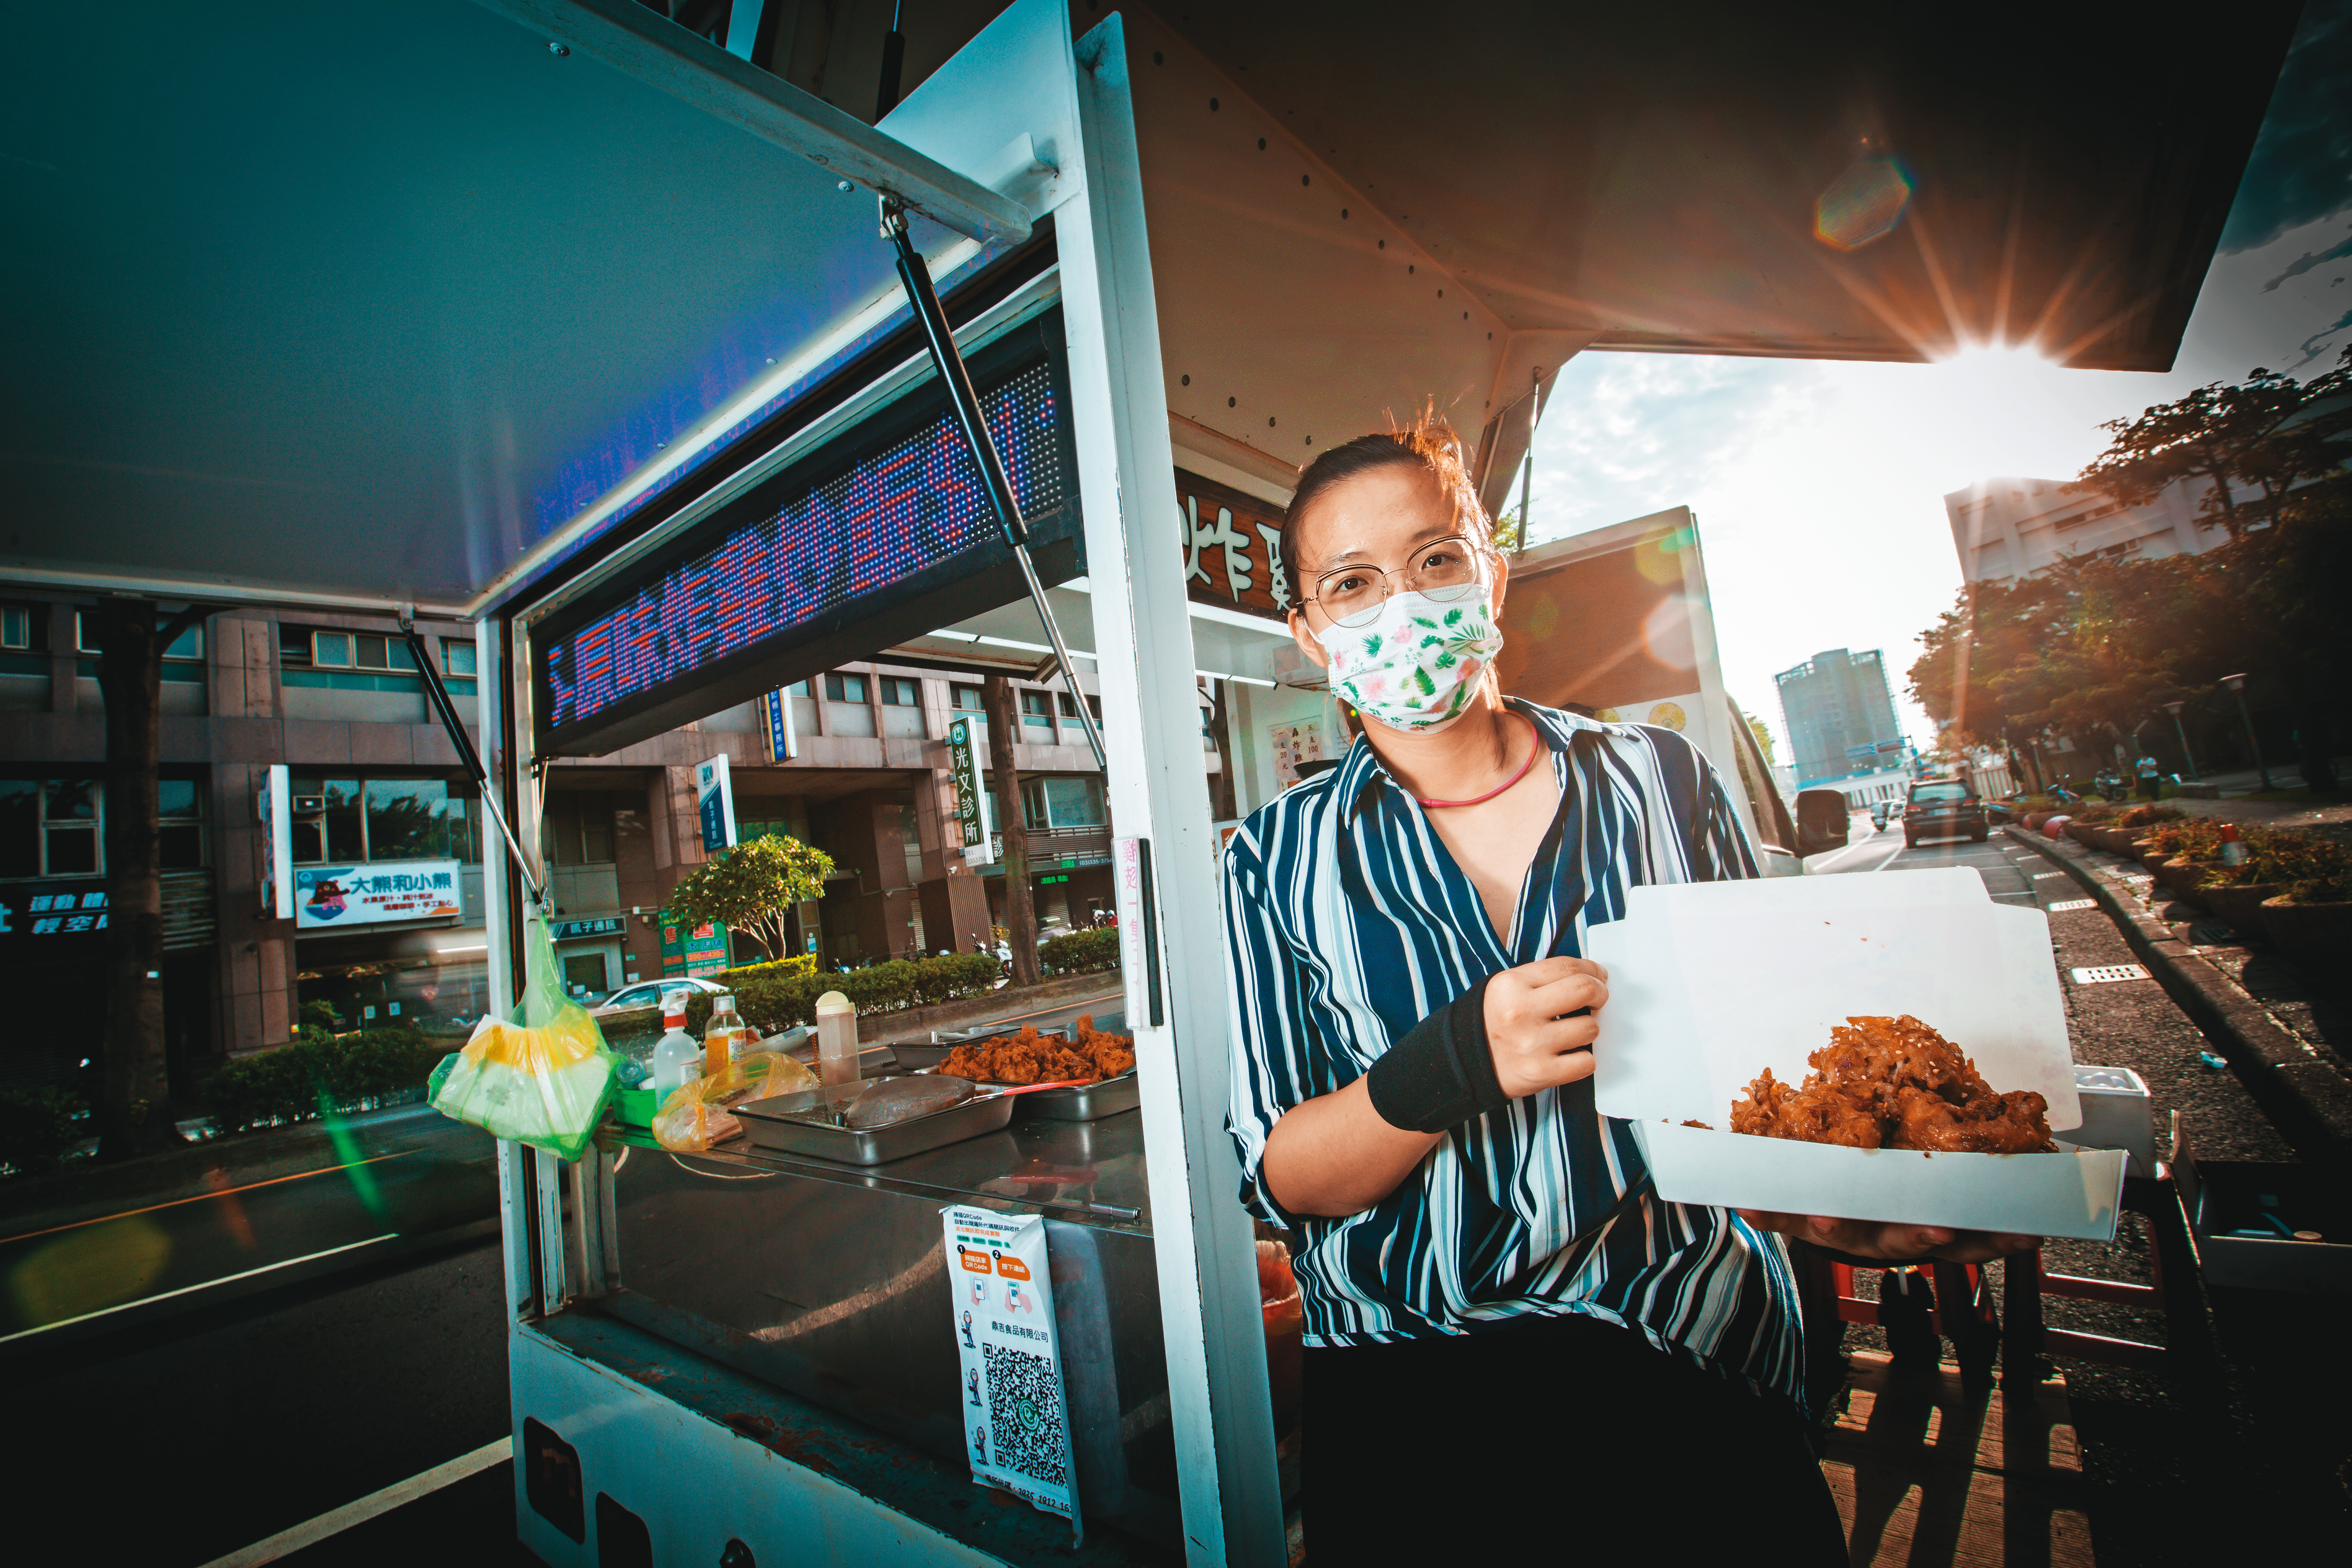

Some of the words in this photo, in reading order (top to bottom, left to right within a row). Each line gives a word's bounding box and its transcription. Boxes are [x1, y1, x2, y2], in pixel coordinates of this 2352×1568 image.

[956, 747, 977, 844] 光文診所
[967, 855, 987, 864] 3353756
[350, 873, 452, 895] 大熊和小熊
[965, 1254, 987, 1264] 掃描店家
[1002, 1263, 1025, 1273] 按下連結
[992, 1321, 1049, 1343] 鼎吉食品有限公司
